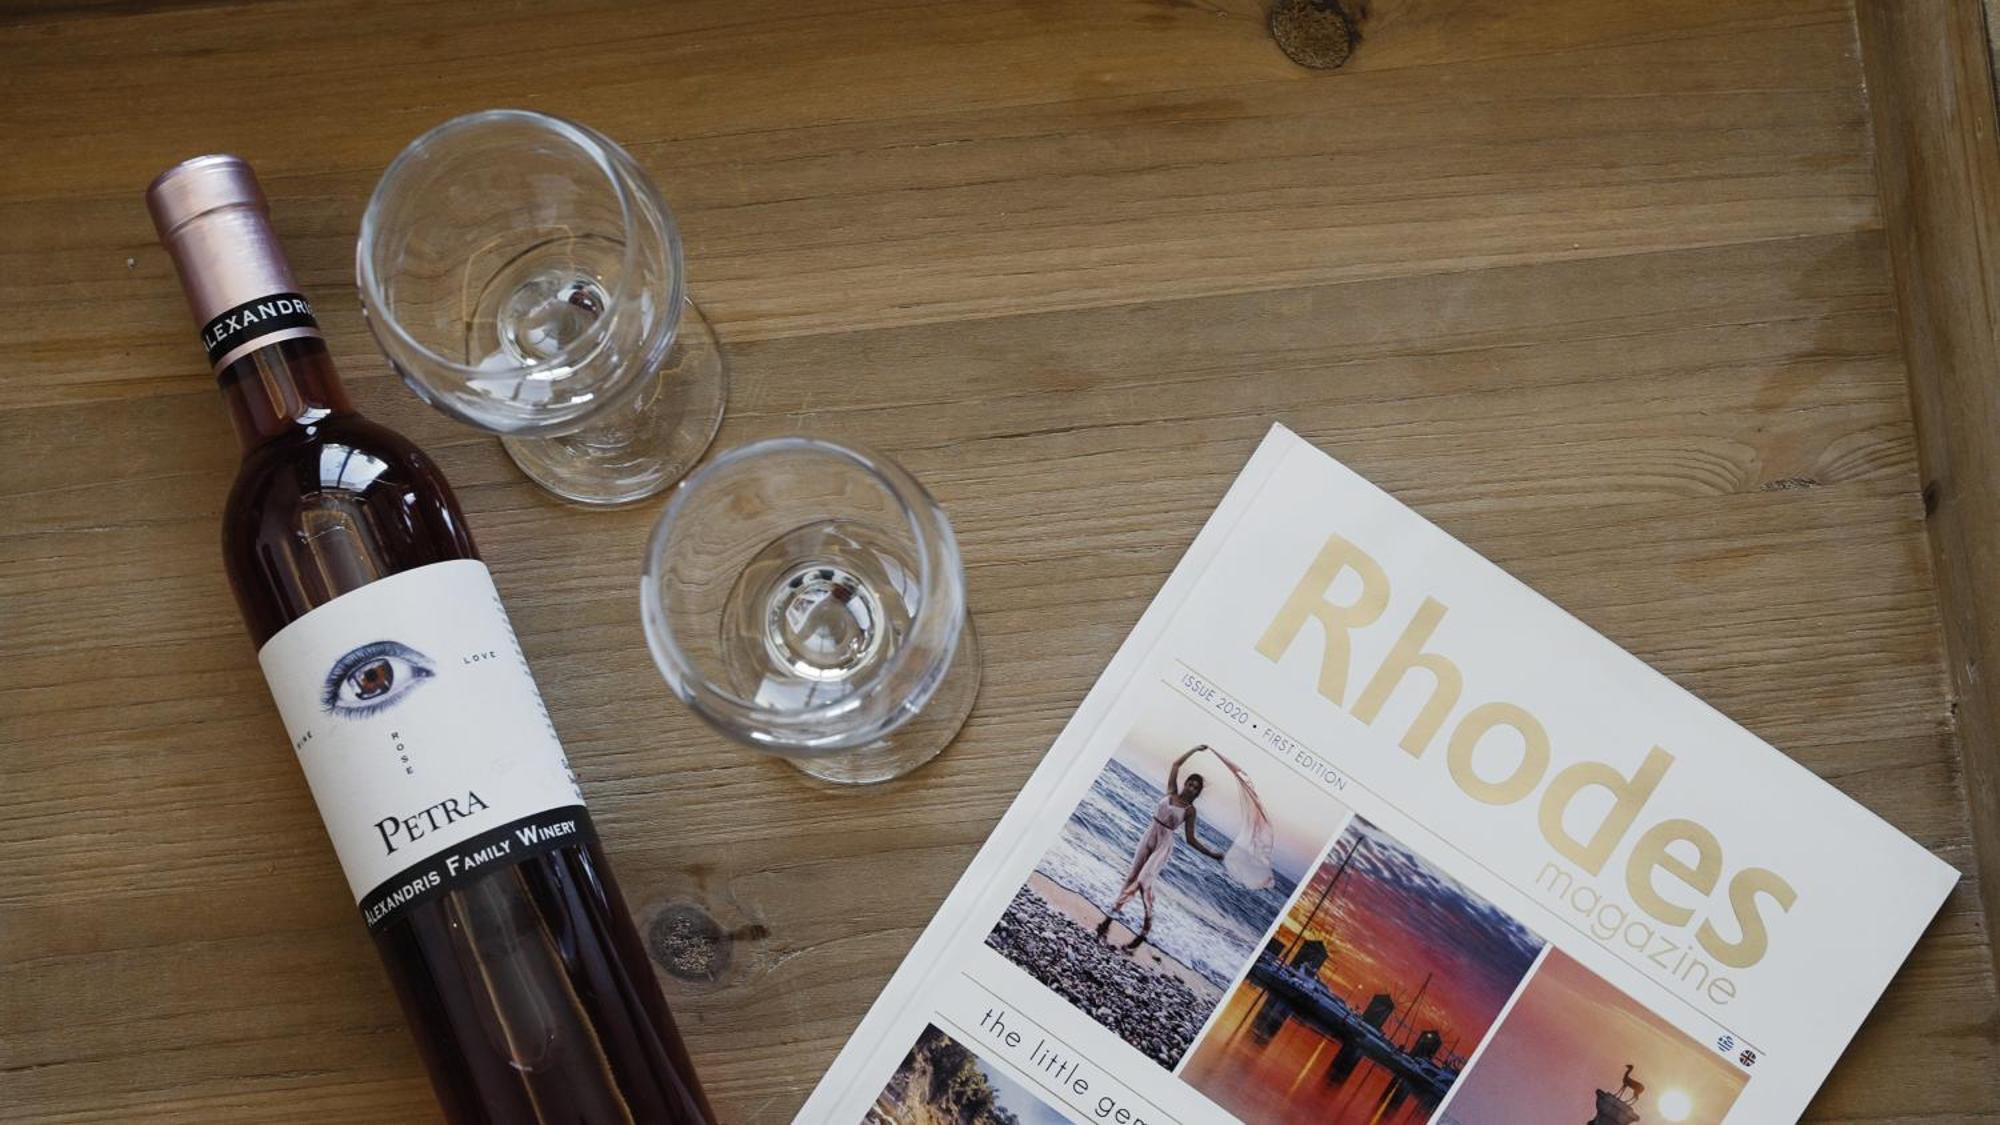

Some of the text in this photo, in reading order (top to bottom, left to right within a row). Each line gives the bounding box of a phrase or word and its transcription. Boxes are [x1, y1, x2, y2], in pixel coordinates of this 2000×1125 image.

[203, 299, 314, 353] LEXANDRI
[463, 651, 496, 664] LOVE
[1181, 673, 1348, 791] ISSUE 2020 FIRST EDITION
[1254, 532, 1798, 969] Rhodes
[1535, 860, 1738, 1006] magazine
[979, 1007, 1022, 1048] the
[1029, 1038, 1090, 1096] little
